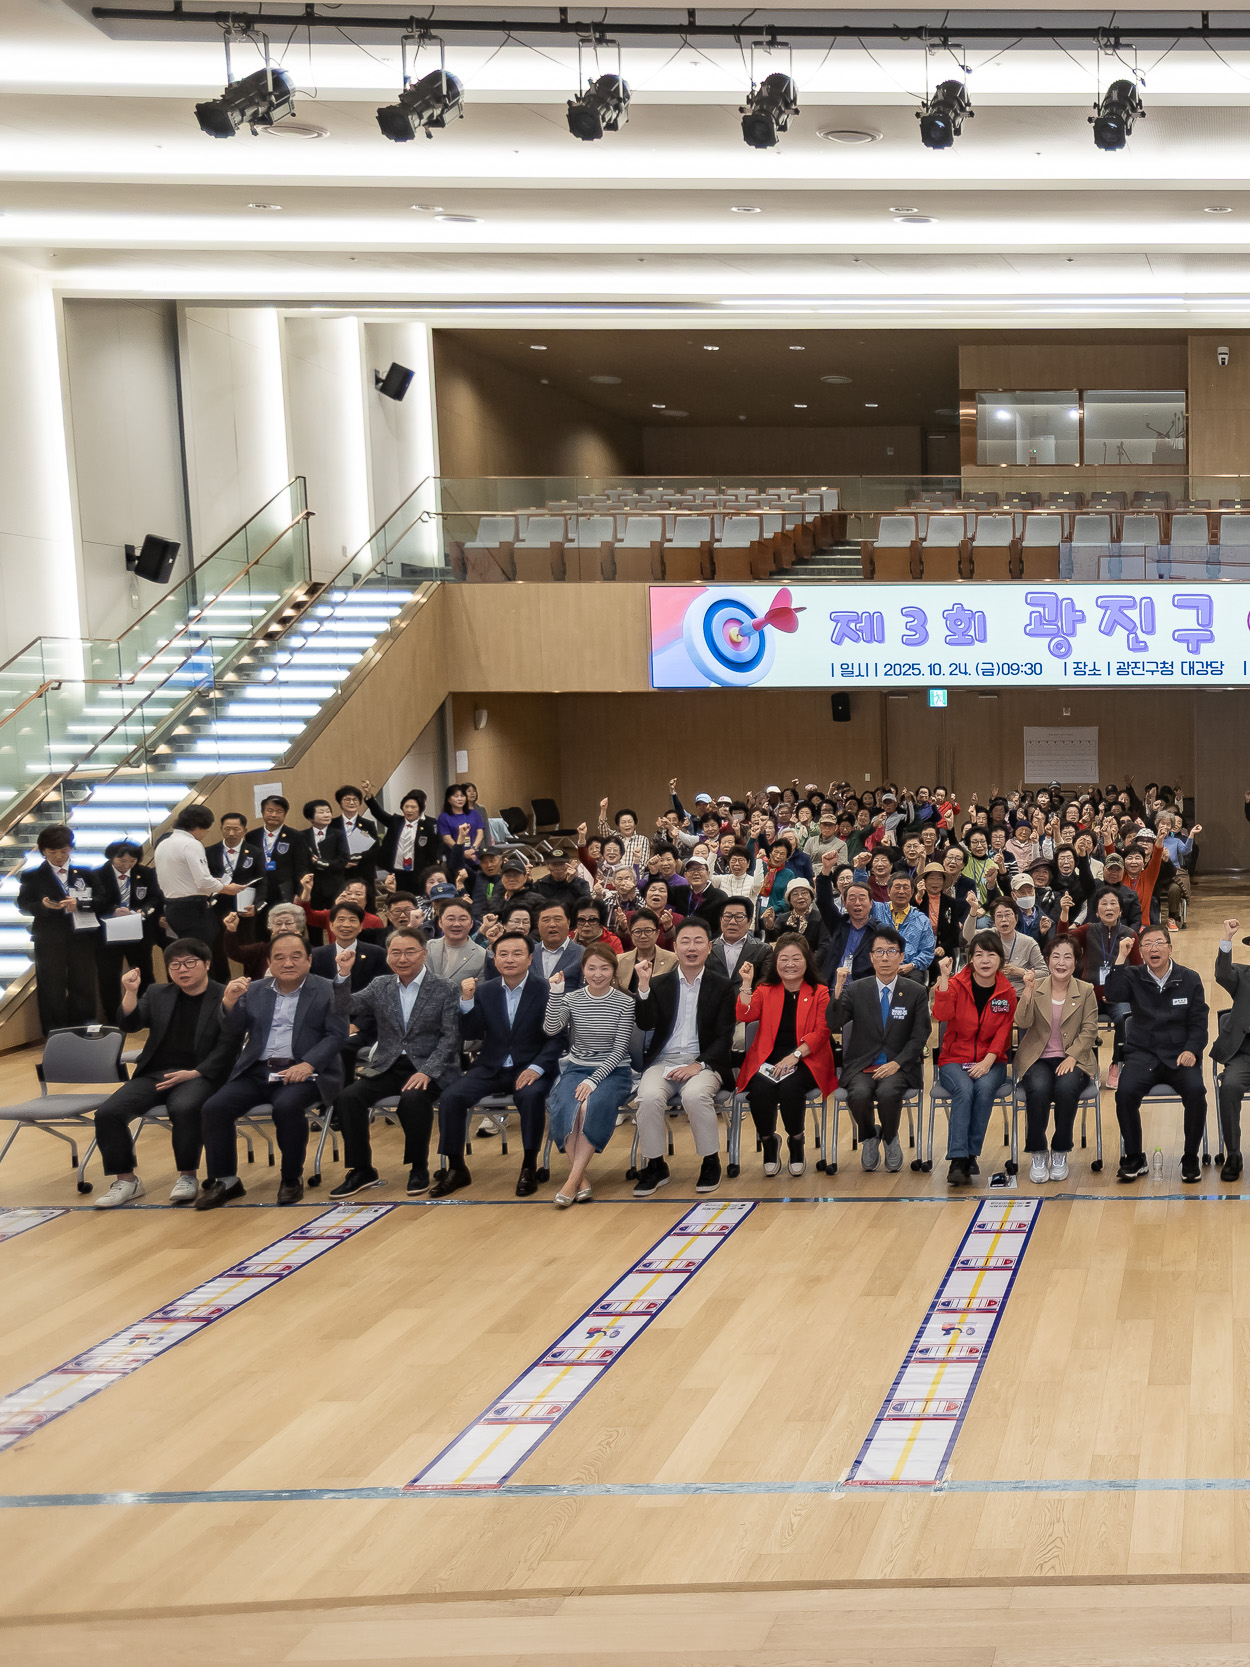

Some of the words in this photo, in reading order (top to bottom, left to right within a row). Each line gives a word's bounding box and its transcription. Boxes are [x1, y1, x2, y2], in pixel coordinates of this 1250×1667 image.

[1023, 591, 1216, 659] 광진구
[840, 662, 869, 677] 일시
[1072, 661, 1103, 676] 장소
[1115, 660, 1175, 676] 광진구청
[1180, 660, 1225, 676] 대강당
